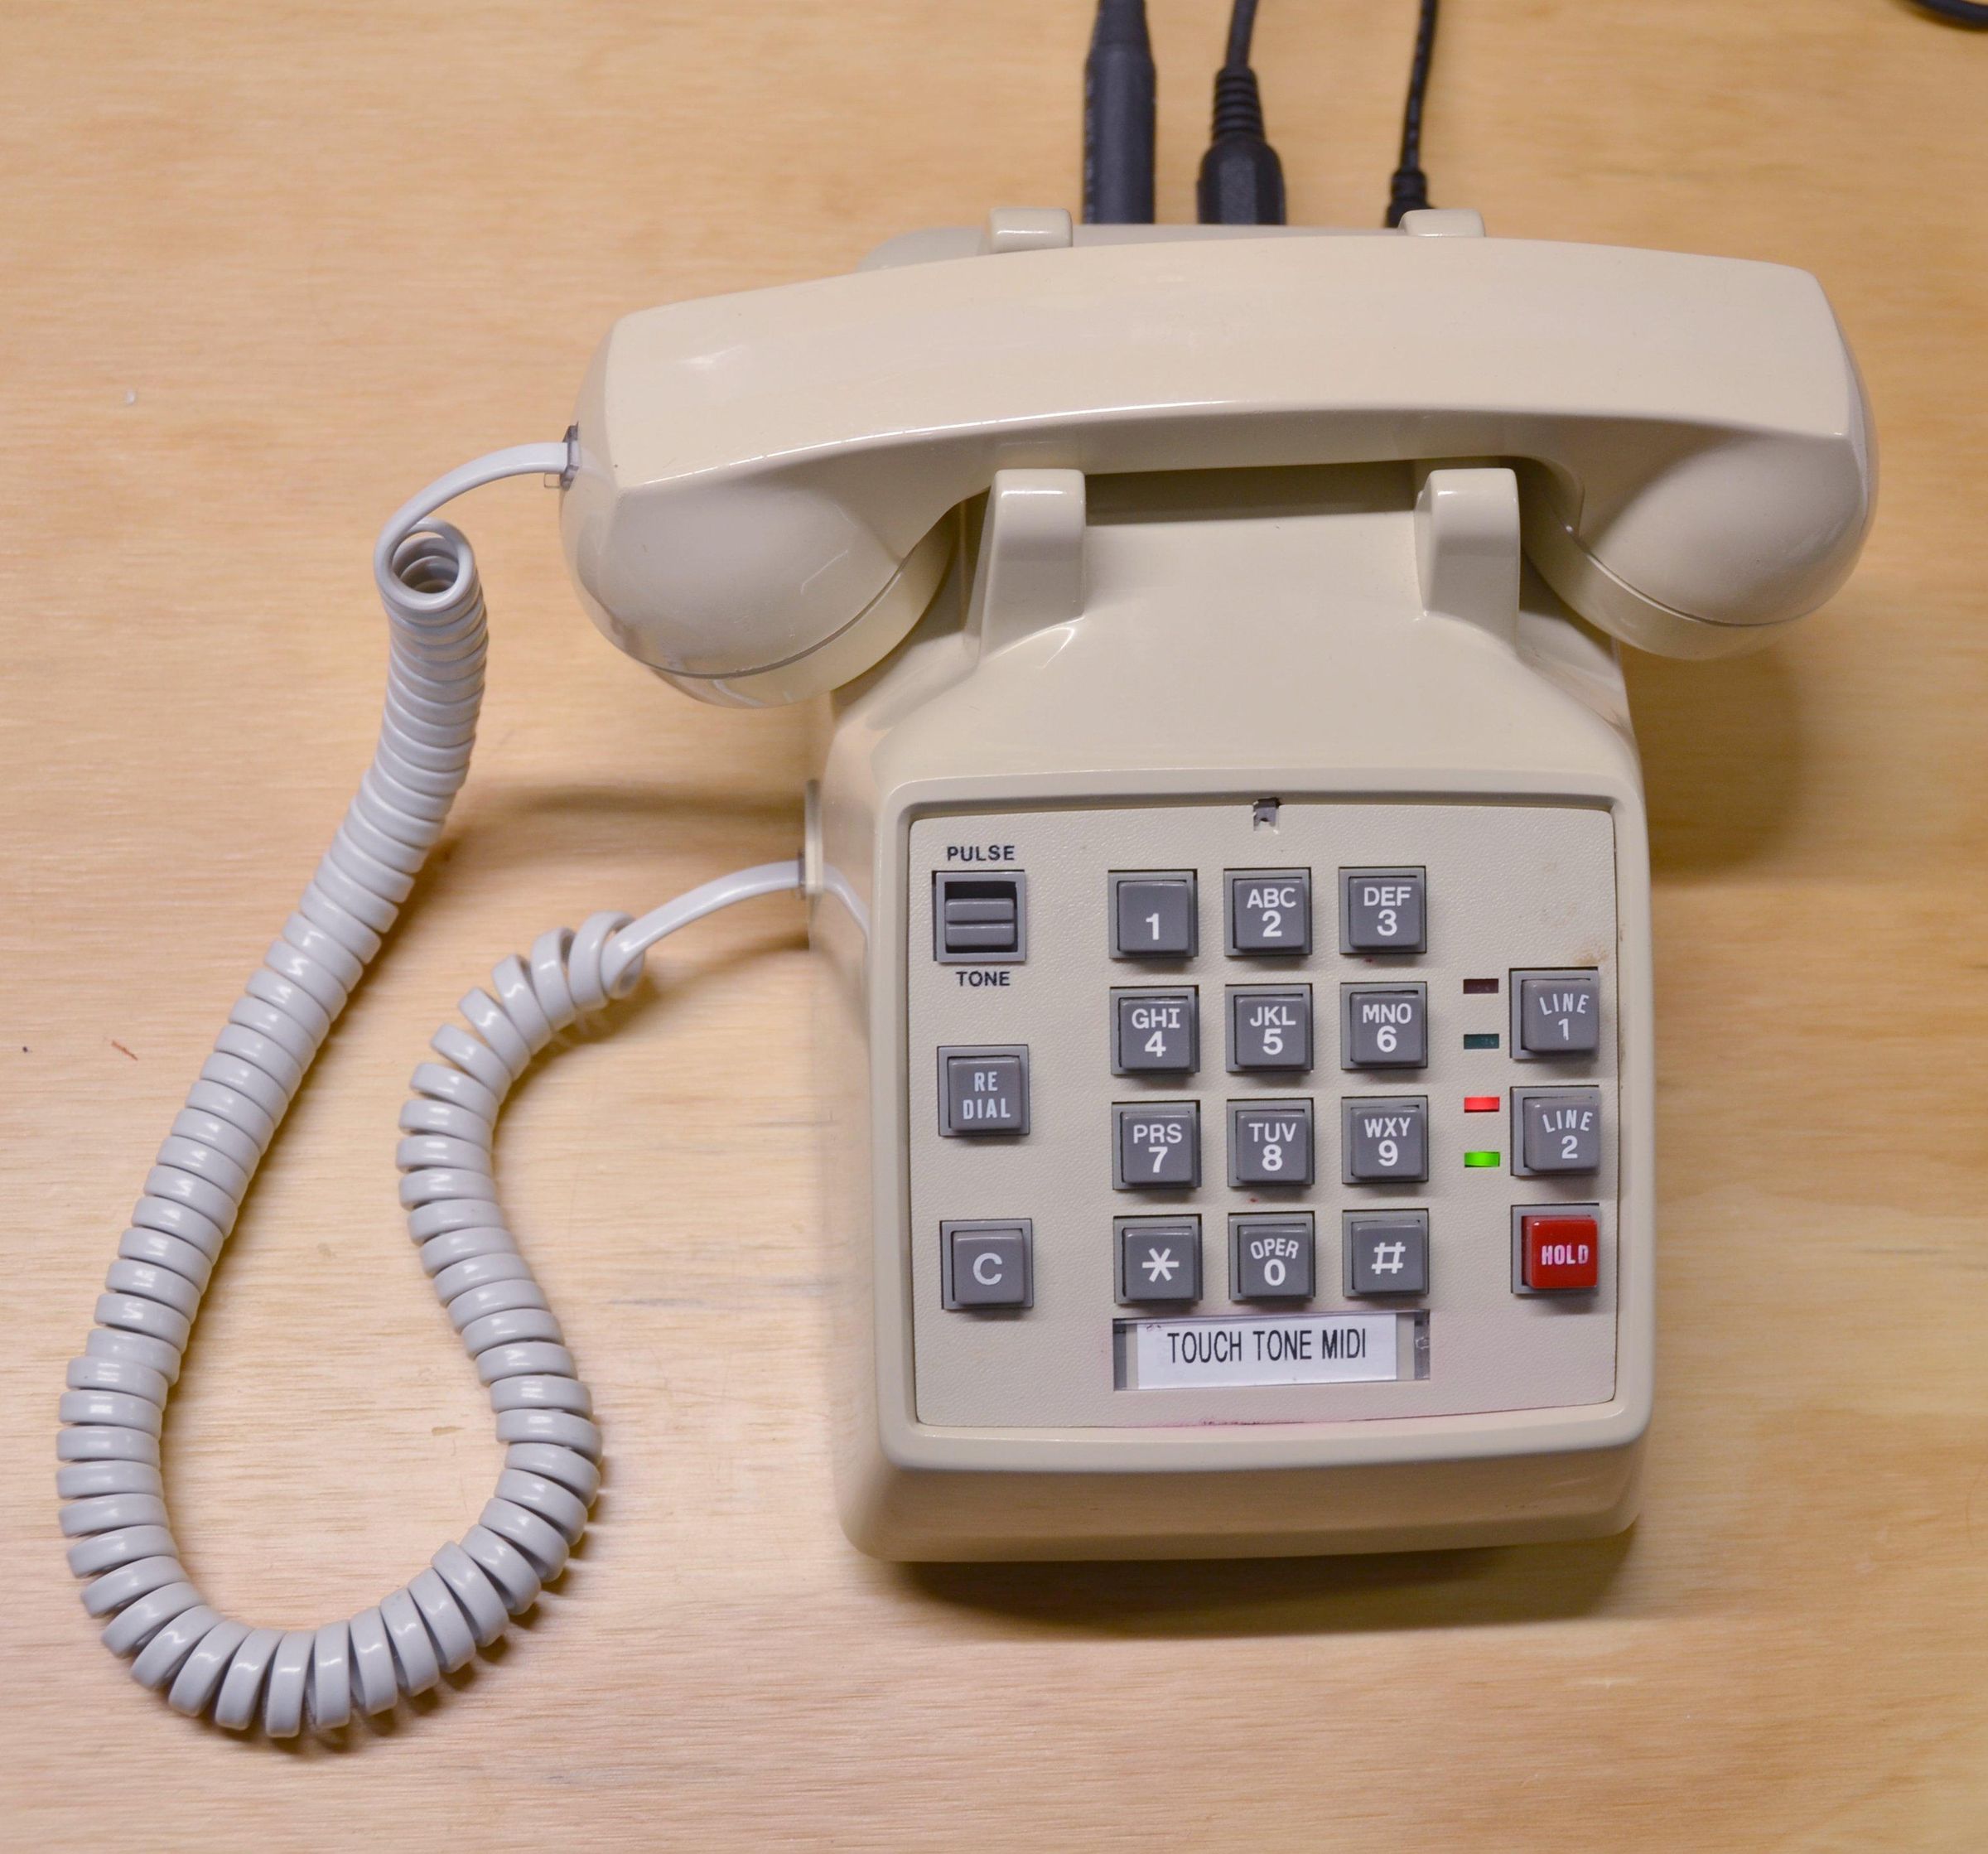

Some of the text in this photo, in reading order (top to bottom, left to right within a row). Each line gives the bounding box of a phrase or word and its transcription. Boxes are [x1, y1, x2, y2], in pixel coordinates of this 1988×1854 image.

[947, 844, 1015, 862] PULSE
[1247, 887, 1296, 909] ABC
[1363, 886, 1411, 906] DEF
[1146, 913, 1160, 940] 1
[1262, 910, 1282, 938] 2
[1377, 909, 1397, 936] 3
[956, 970, 1011, 987] TONE
[1363, 1002, 1412, 1024] MNO
[1539, 993, 1590, 1016] LINE
[1132, 1007, 1180, 1029] GHI
[1249, 1006, 1296, 1027] JKL
[1377, 1025, 1397, 1053] 6
[1558, 1018, 1569, 1040] 1
[1145, 1031, 1166, 1057] 4
[1262, 1028, 1283, 1055] 5
[974, 1071, 998, 1092] RE
[963, 1098, 1011, 1120] DIAL
[1248, 1123, 1296, 1142] TUV
[1364, 1117, 1411, 1138] WXY
[1542, 1109, 1593, 1133] LINE
[1133, 1123, 1182, 1144] PRS
[1262, 1144, 1283, 1171] 8
[1378, 1139, 1398, 1166] 9
[1561, 1135, 1578, 1159] 2
[1148, 1146, 1168, 1173] 7
[1250, 1238, 1299, 1260] OPER
[1371, 1241, 1406, 1275] #
[1542, 1244, 1589, 1266] HOLD
[972, 1253, 1002, 1286] C
[1264, 1258, 1286, 1287] 0
[1167, 1328, 1366, 1364] TOUCH TONE MIDI
